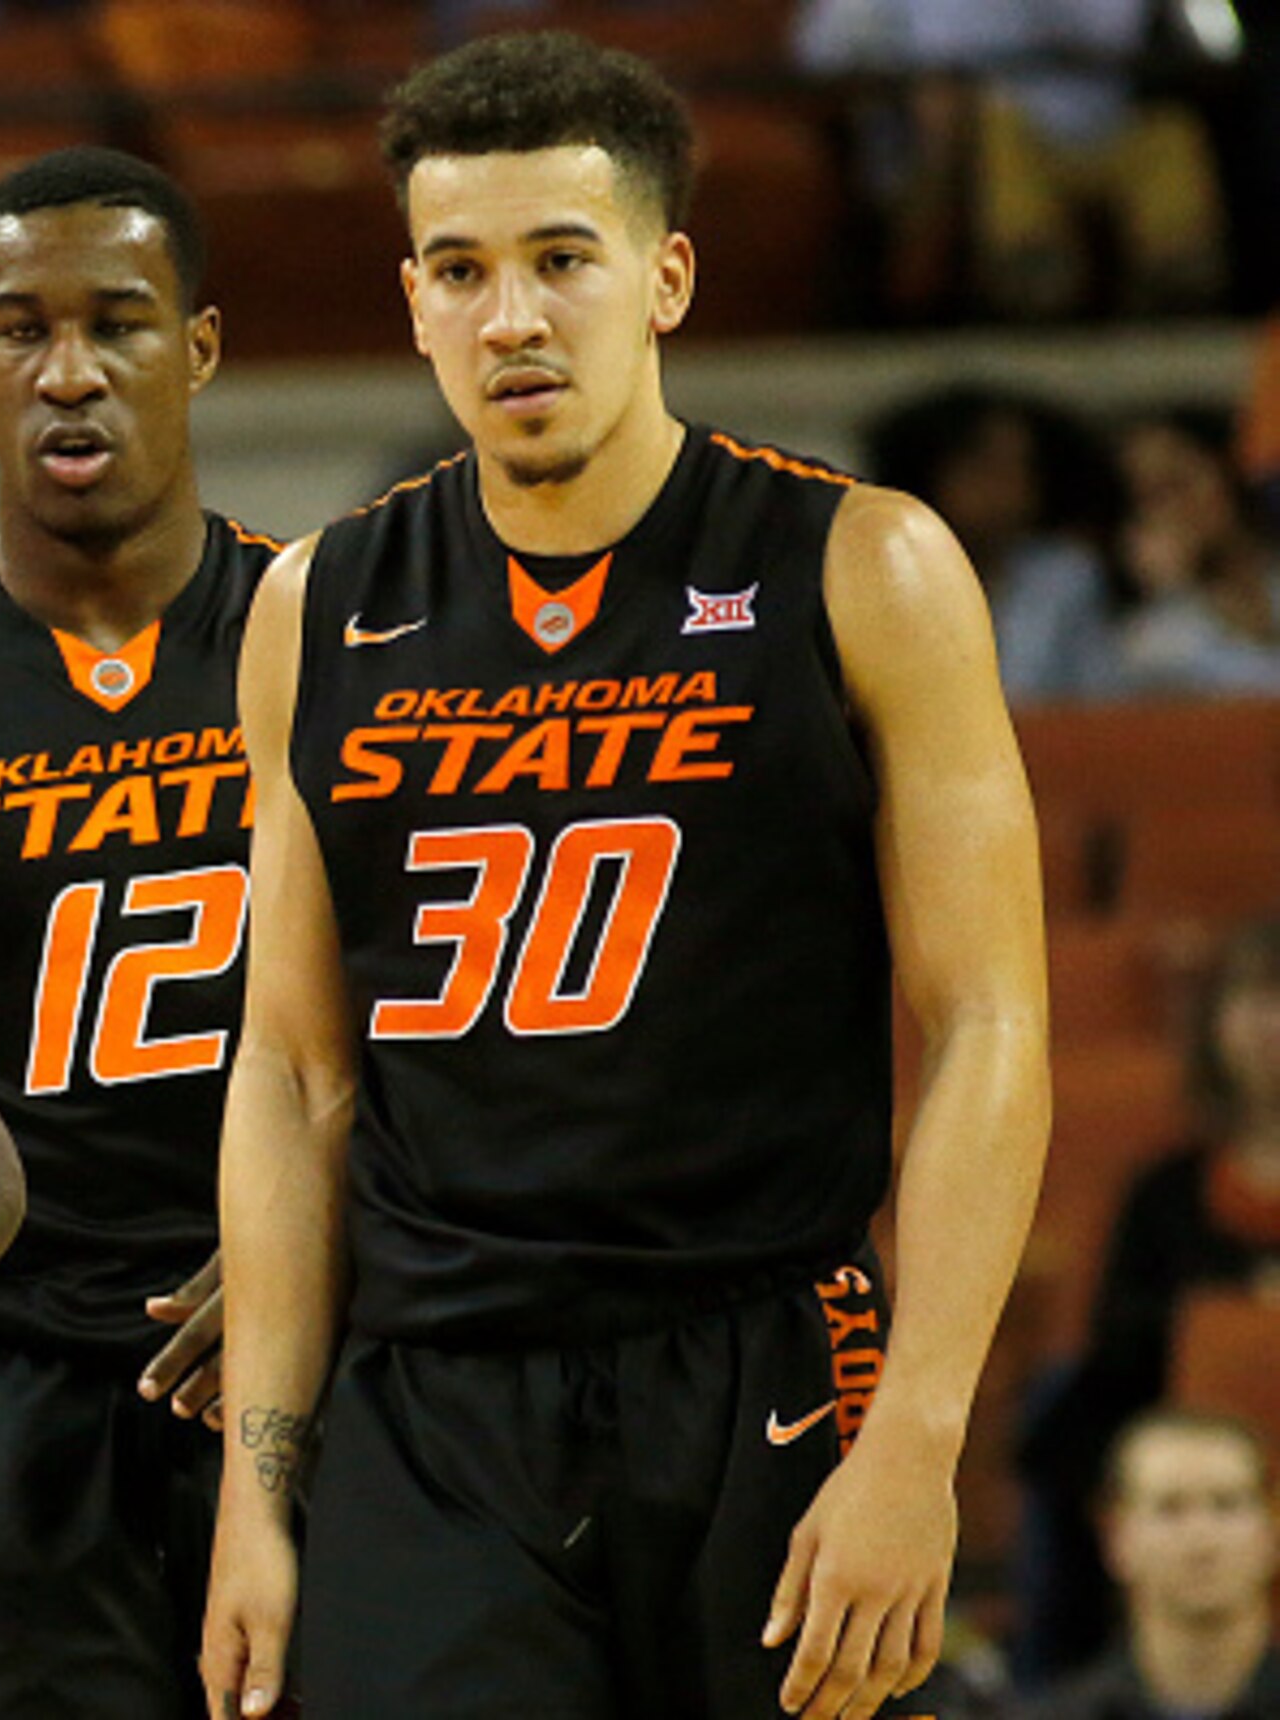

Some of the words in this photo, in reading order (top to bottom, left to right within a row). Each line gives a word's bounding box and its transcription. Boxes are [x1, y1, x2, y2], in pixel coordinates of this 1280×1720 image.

[331, 705, 754, 802] STATE
[374, 671, 717, 721] OKLAHOMA
[24, 862, 251, 1096] 12
[368, 814, 683, 1041] 30
[814, 1265, 885, 1457] BOYS
